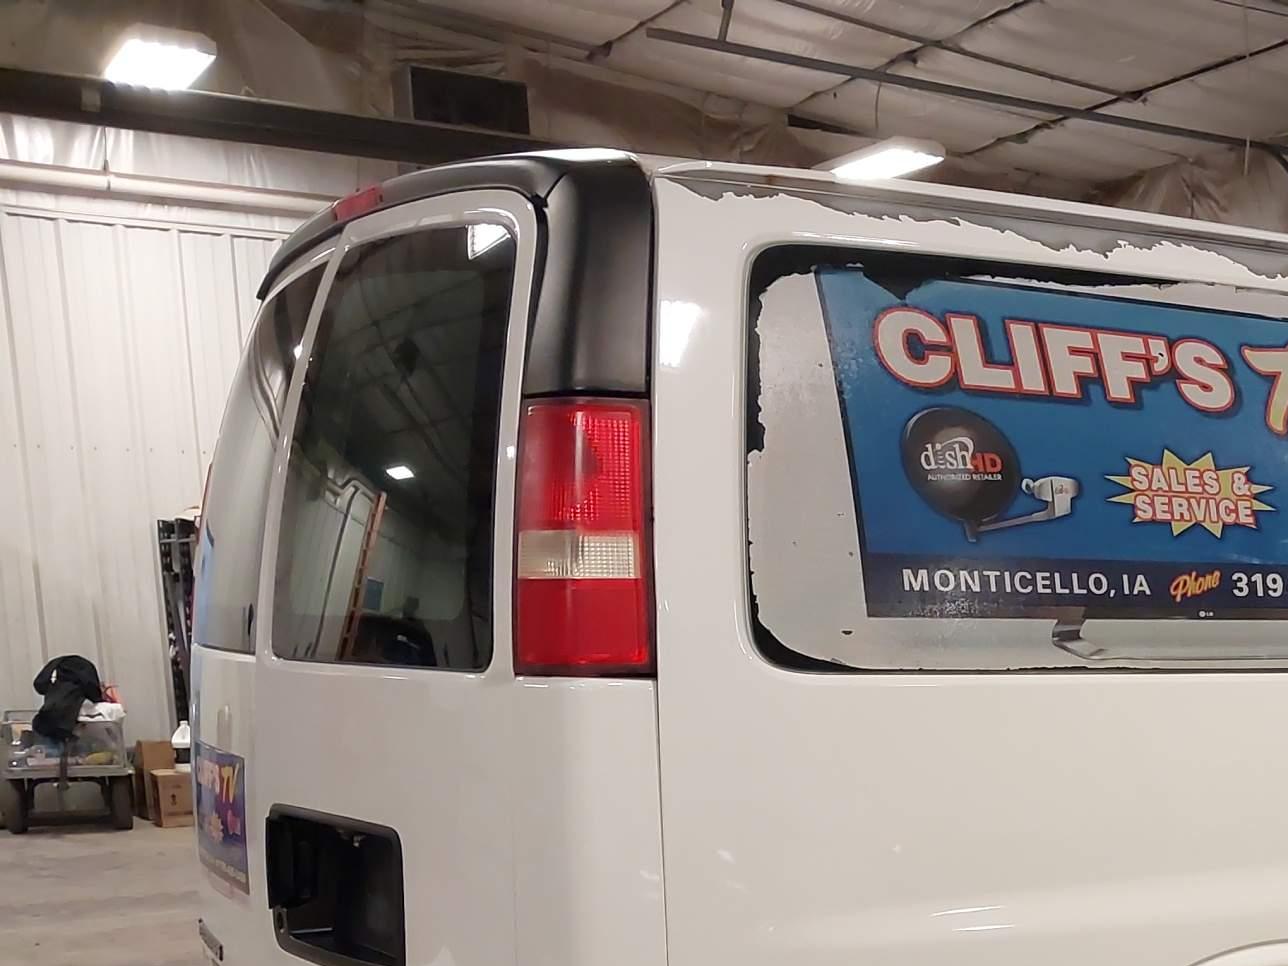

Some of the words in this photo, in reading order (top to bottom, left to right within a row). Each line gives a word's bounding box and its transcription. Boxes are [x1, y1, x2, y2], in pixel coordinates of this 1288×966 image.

[873, 306, 1236, 413] CLIFF'S
[1130, 464, 1221, 495] SALES
[1231, 470, 1252, 496] &
[1134, 494, 1256, 525] SERVICE
[902, 568, 1116, 598] MONTICELLO,
[1122, 574, 1151, 595] IA
[1169, 570, 1221, 602] Phone
